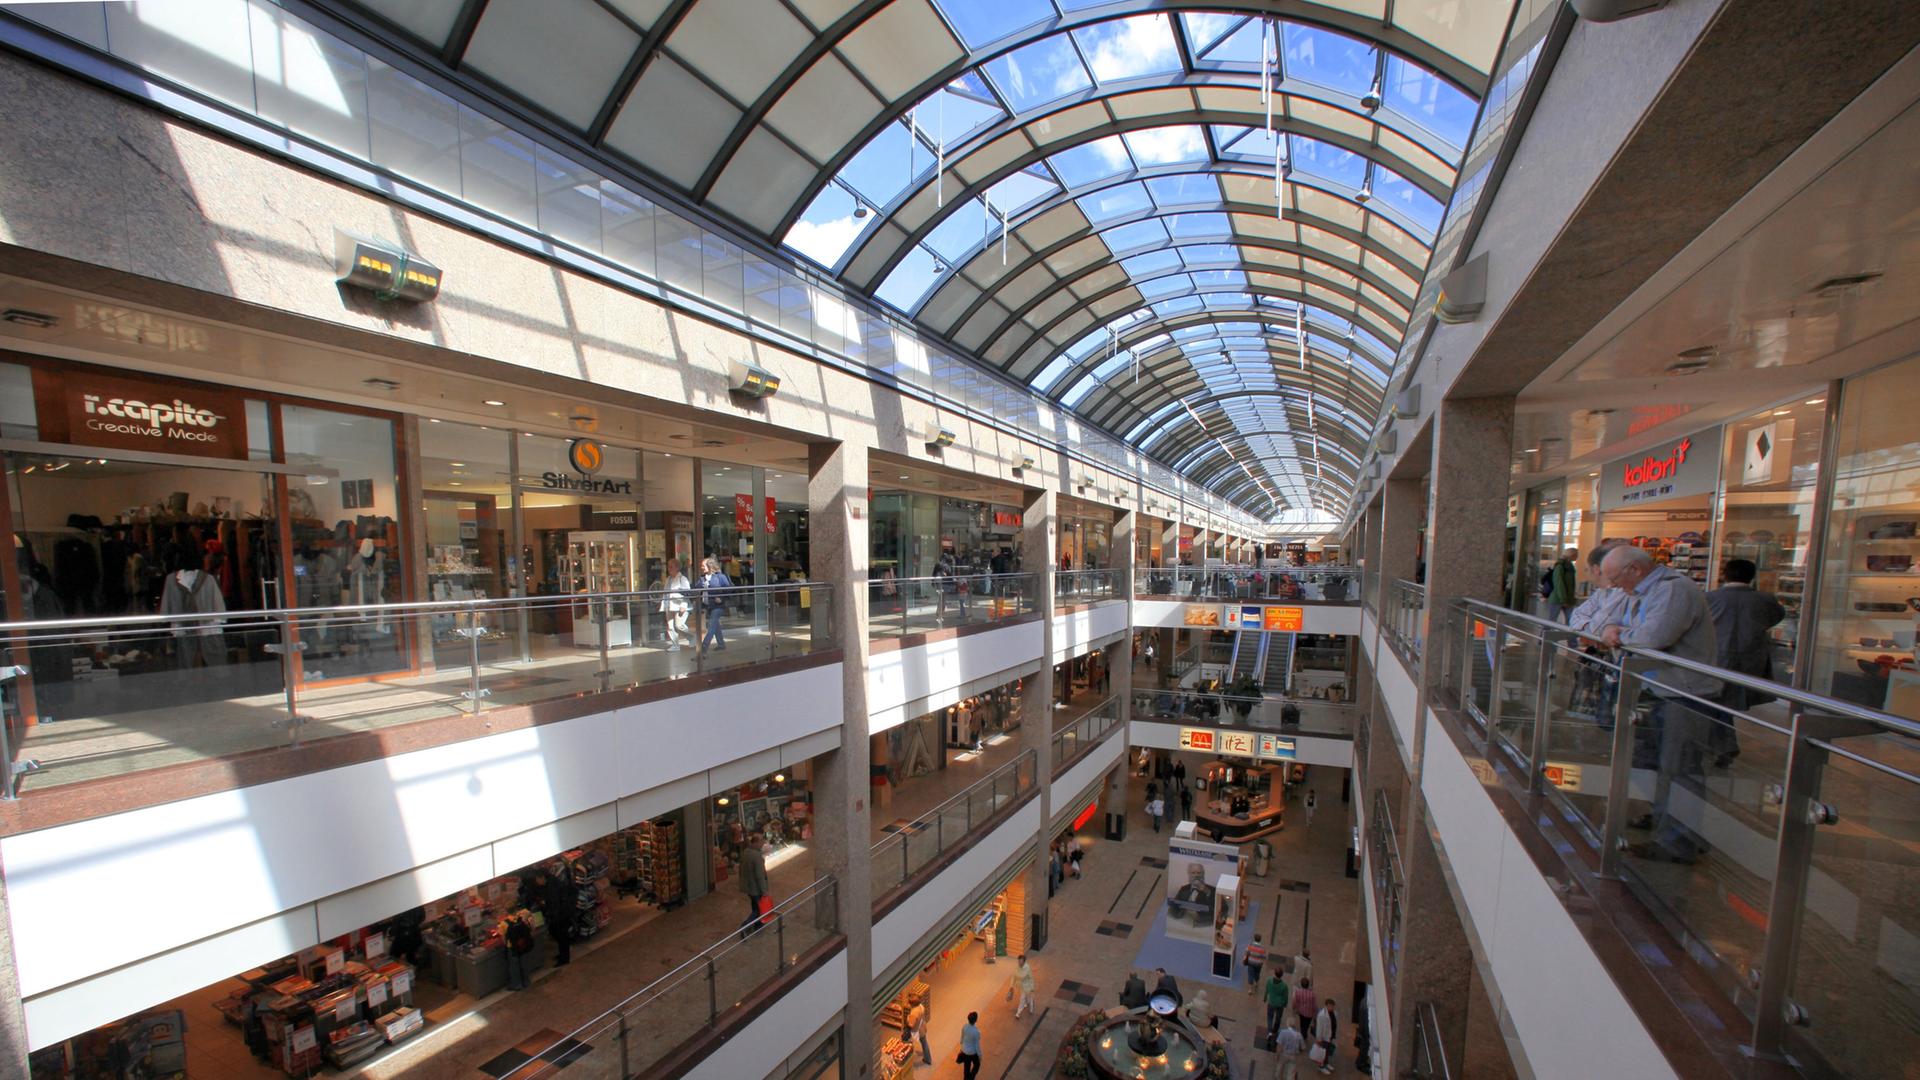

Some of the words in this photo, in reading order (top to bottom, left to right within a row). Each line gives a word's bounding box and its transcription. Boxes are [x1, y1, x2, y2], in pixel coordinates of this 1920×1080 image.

[84, 394, 226, 428] r.capito
[87, 419, 163, 436] Creative
[168, 428, 218, 443] Mode
[1623, 448, 1677, 488] kolibri
[542, 471, 631, 494] SilverArt
[610, 515, 635, 525] FOSSIL
